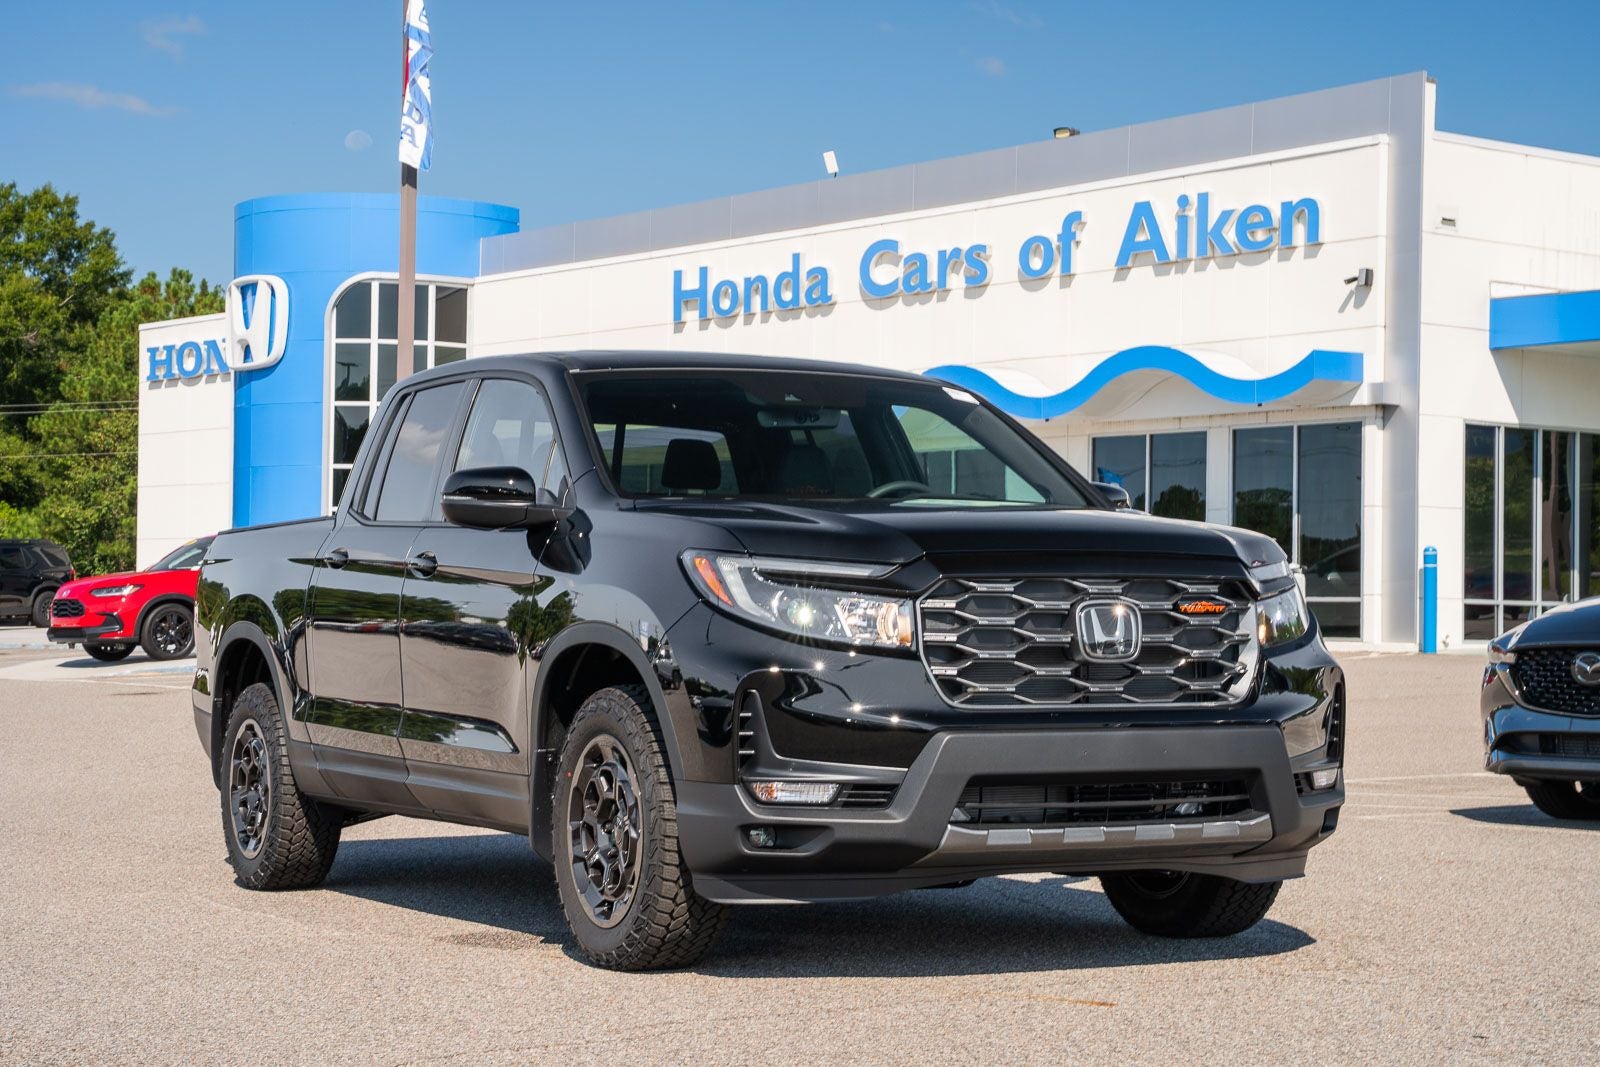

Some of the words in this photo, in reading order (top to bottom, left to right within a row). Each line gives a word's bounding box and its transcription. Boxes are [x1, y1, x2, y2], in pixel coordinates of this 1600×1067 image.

[673, 253, 832, 321] Honda
[860, 240, 987, 297] Cars
[1019, 211, 1082, 277] of
[1116, 192, 1319, 267] Aiken
